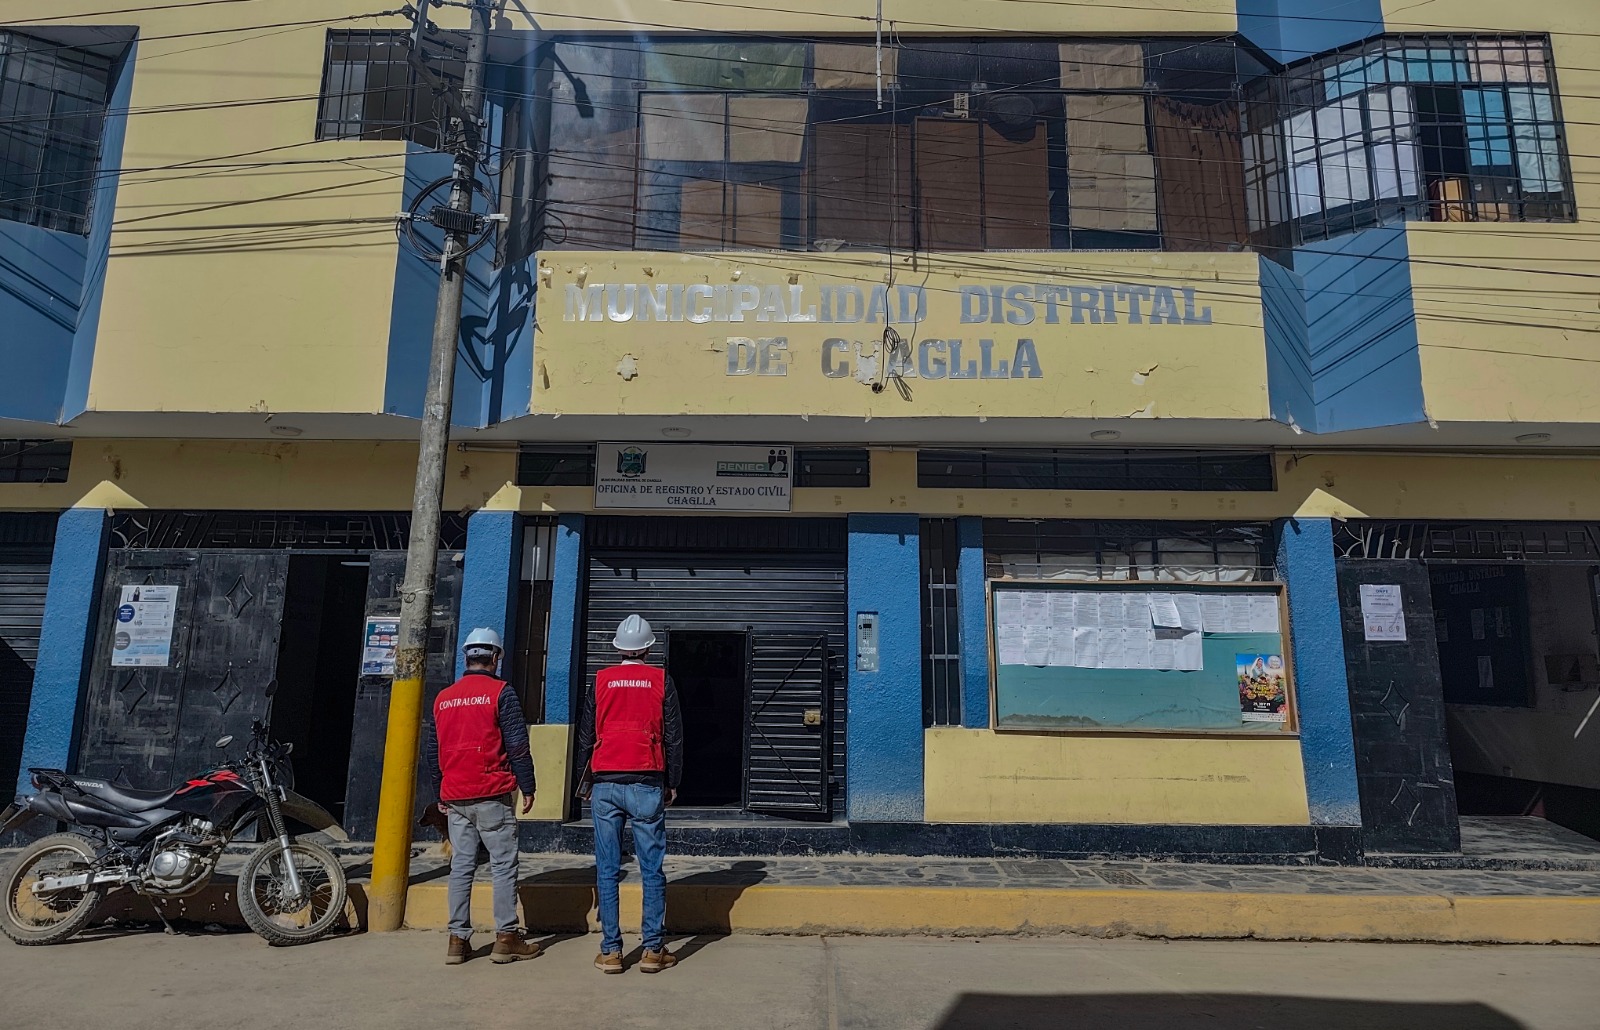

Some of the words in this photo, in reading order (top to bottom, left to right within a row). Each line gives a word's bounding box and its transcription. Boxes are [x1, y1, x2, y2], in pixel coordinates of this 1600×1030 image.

[563, 284, 927, 323] MUNICIPALIDAD
[960, 284, 1212, 325] DISTRITAL
[726, 337, 787, 376] DE
[821, 338, 1043, 379] CAGLLA
[718, 462, 765, 471] RENIEC
[598, 485, 637, 494] OFICINA
[640, 486, 653, 494] DE
[655, 486, 704, 495] REGISTRO
[706, 485, 715, 495] Y
[715, 486, 755, 496] ESTADO
[757, 486, 787, 496] CIVIL
[667, 496, 716, 506] CHAGLLA
[607, 679, 652, 689] CONTRALORÍA
[439, 694, 491, 711] CONTRALORÍA
[74, 780, 104, 789] HONDA
